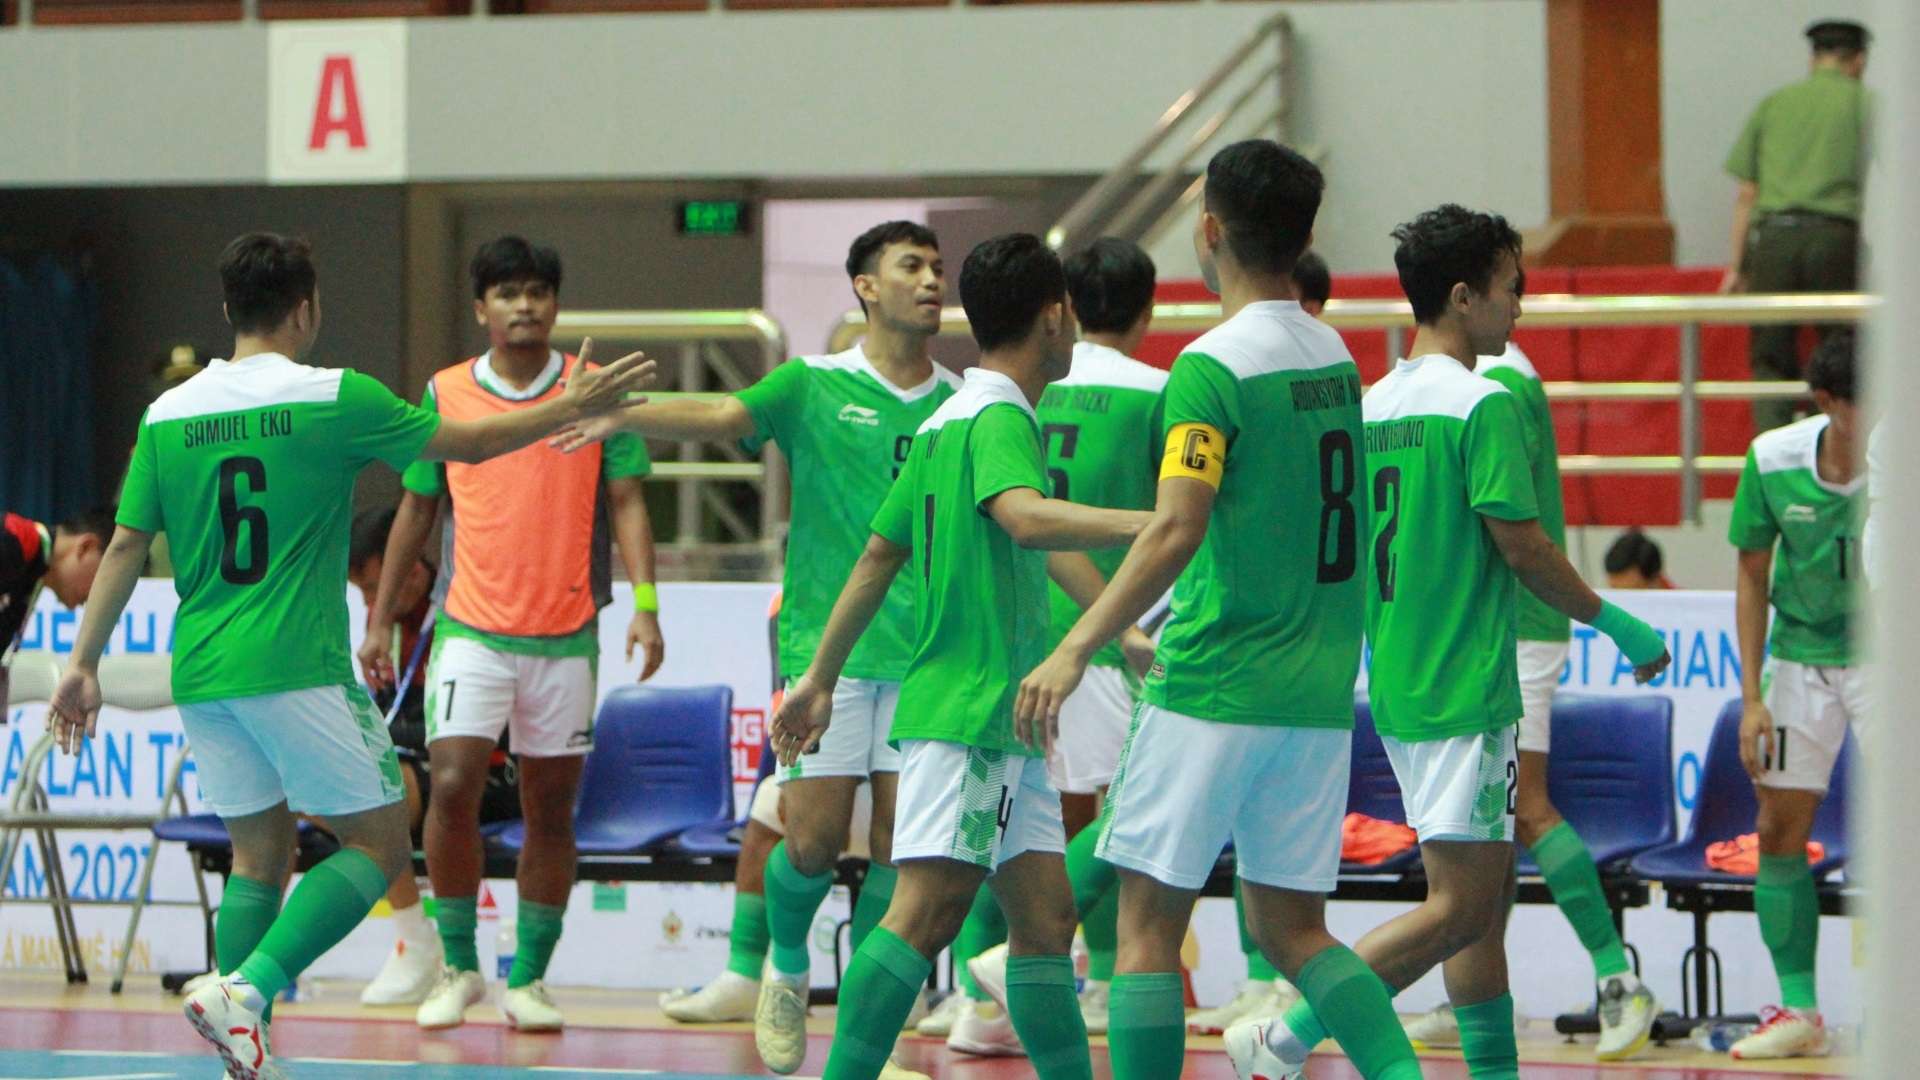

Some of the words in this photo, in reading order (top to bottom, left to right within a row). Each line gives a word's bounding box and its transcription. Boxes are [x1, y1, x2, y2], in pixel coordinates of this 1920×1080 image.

[309, 56, 367, 149] A
[184, 415, 249, 448] SAMUEL
[260, 409, 292, 438] EKO
[1181, 428, 1210, 472] C
[218, 456, 269, 586] 6
[1317, 429, 1357, 584] 8
